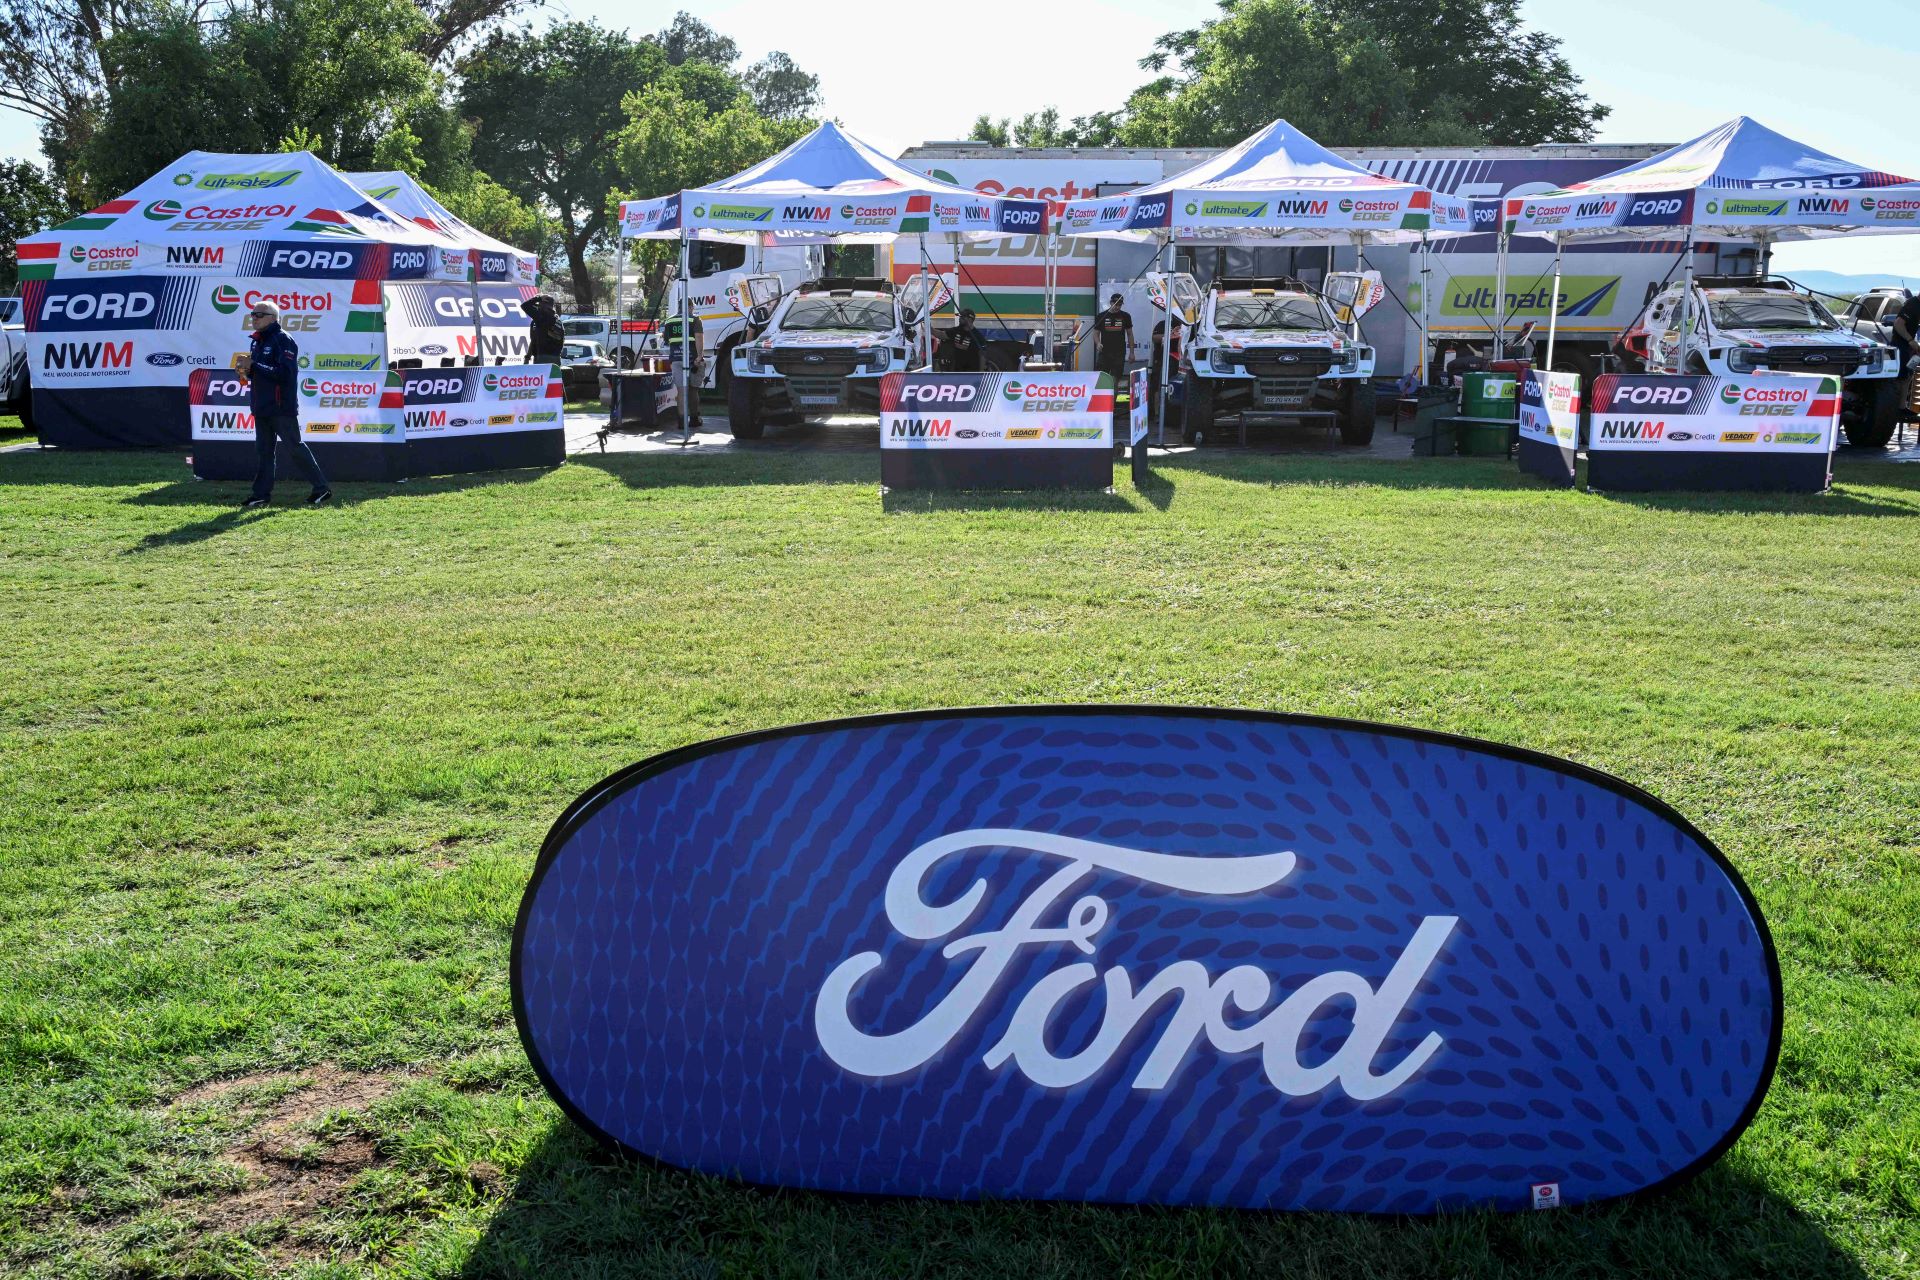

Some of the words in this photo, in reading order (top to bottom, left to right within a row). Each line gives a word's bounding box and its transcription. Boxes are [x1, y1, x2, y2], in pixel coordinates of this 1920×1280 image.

[204, 176, 270, 188] ultimate
[1751, 175, 1861, 189] FORD
[184, 204, 297, 220] Castrol
[856, 206, 897, 217] Castrol
[941, 205, 960, 216] Castrol
[1135, 203, 1165, 220] FORD
[1205, 206, 1249, 215] ultimate
[1278, 200, 1329, 214] NWM
[1354, 200, 1399, 211] Castrol
[1537, 204, 1571, 215] Castrol
[1576, 200, 1617, 216] NWM
[1630, 199, 1682, 216] FORD
[1726, 204, 1769, 213] ultimate
[1798, 198, 1849, 212] NWM
[713, 209, 755, 219] ultimate
[783, 206, 831, 220] NWM
[965, 206, 990, 219] NWM
[1002, 209, 1040, 224] FORD
[1074, 208, 1097, 218] Castrol
[1101, 206, 1129, 220] NWM
[1352, 212, 1392, 221] EDGE
[1875, 210, 1917, 219] EDGE
[167, 218, 272, 231] EDGE
[853, 217, 891, 225] EDGE
[1533, 215, 1565, 225] EDGE
[88, 245, 139, 259] Castrol
[166, 246, 224, 263] NWM
[271, 249, 353, 269] FORD
[446, 250, 464, 265] Castrol
[87, 259, 133, 272] EDGE
[393, 252, 425, 269] FORD
[482, 257, 506, 273] FORD
[41, 292, 155, 321] FORD
[691, 295, 716, 306] WM
[44, 341, 134, 369] NWM
[186, 355, 216, 365] Credit
[319, 358, 362, 368] ultimate
[207, 380, 251, 397] FO
[320, 381, 376, 395] Castrol
[404, 378, 463, 396] FORD
[500, 375, 543, 388] Castrol
[499, 388, 538, 401] EDGE
[900, 385, 976, 402] FORD
[1025, 383, 1085, 398] Castrol
[1524, 381, 1542, 397] FORD
[1612, 386, 1692, 404] FORD
[1743, 387, 1808, 402] Castrol
[319, 397, 369, 409] EDGE
[1022, 400, 1077, 412] EDGE
[1738, 404, 1798, 416] EDGE
[201, 412, 255, 429] NWM
[890, 419, 952, 437] NWM
[981, 430, 1001, 438] Credit
[1600, 420, 1665, 438] NWM
[1694, 433, 1716, 441] Credit
[1724, 432, 1754, 440] VEDACIT
[814, 827, 1461, 1102] Ford
